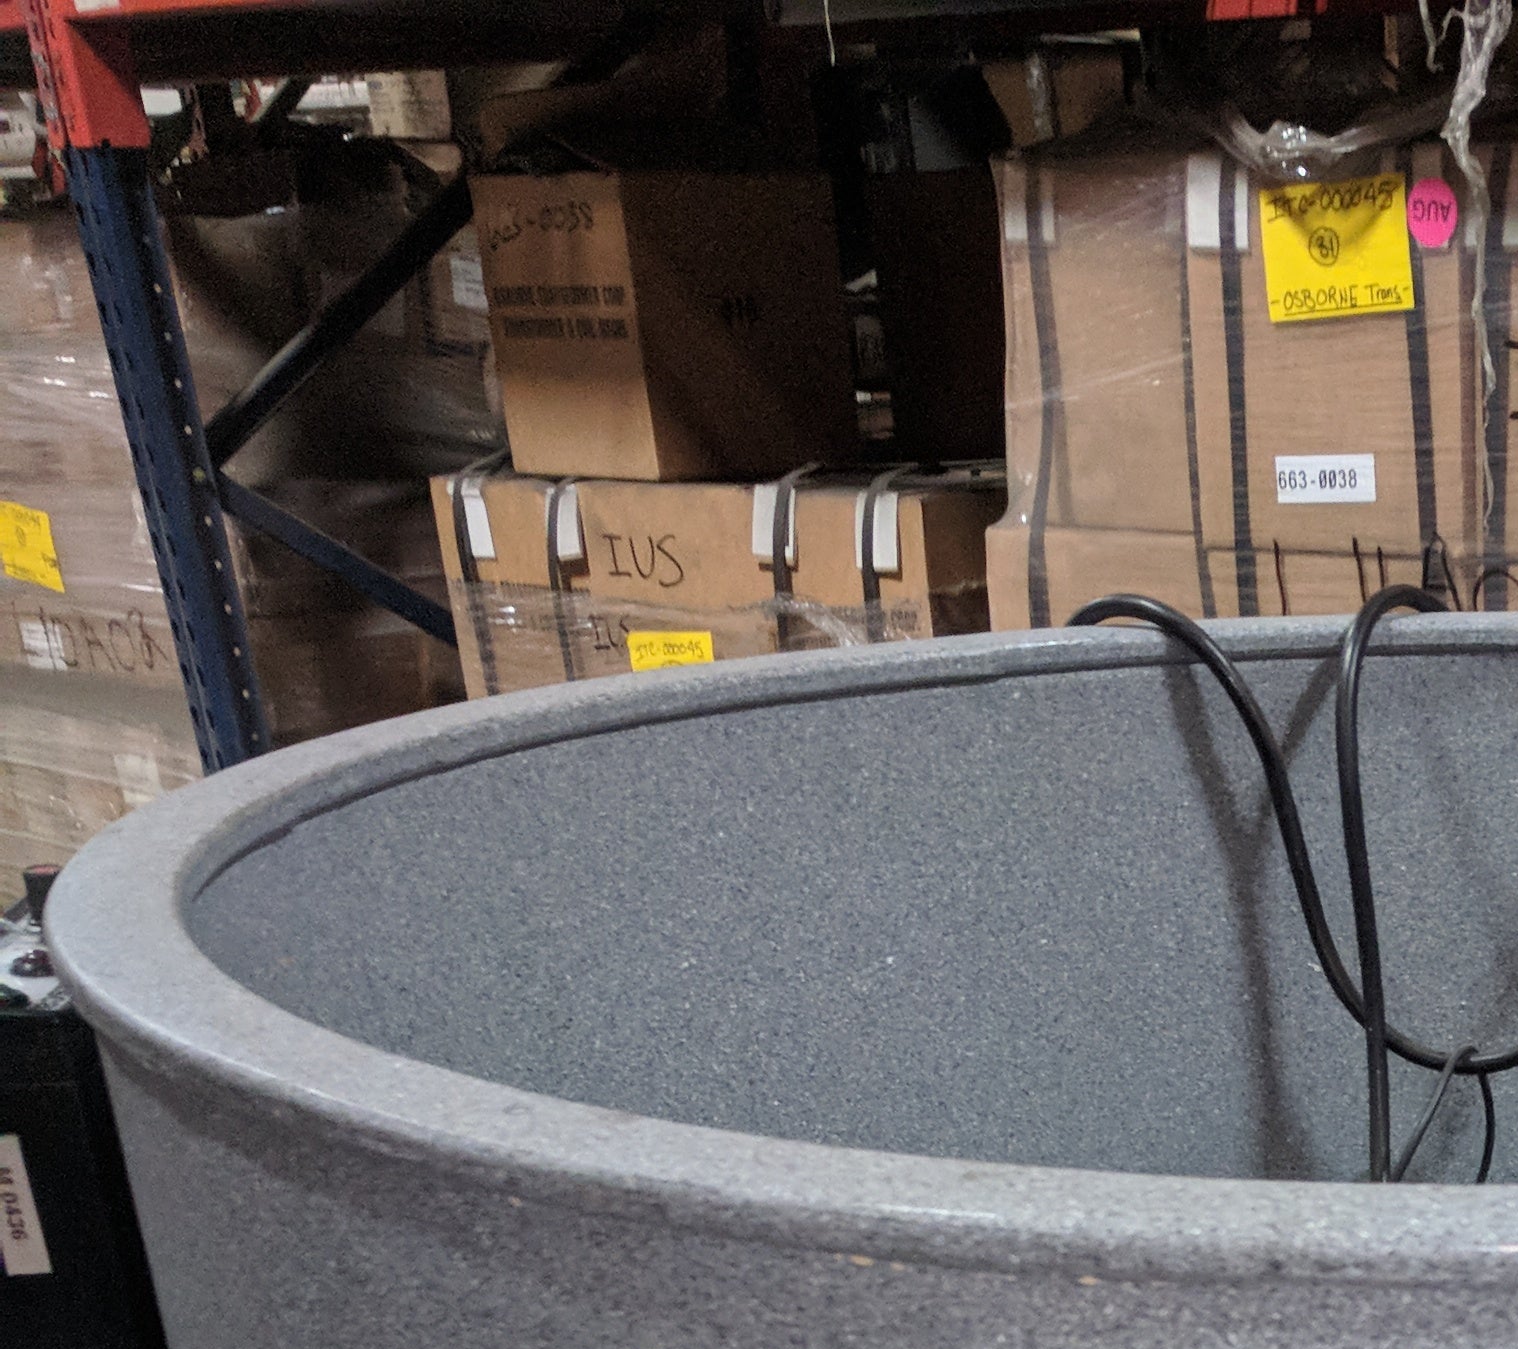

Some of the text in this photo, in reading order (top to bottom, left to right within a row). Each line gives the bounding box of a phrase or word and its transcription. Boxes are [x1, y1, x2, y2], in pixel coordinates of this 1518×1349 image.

[1411, 199, 1450, 222] AUG
[1277, 468, 1359, 491] 663-0038
[601, 532, 685, 589] IUS
